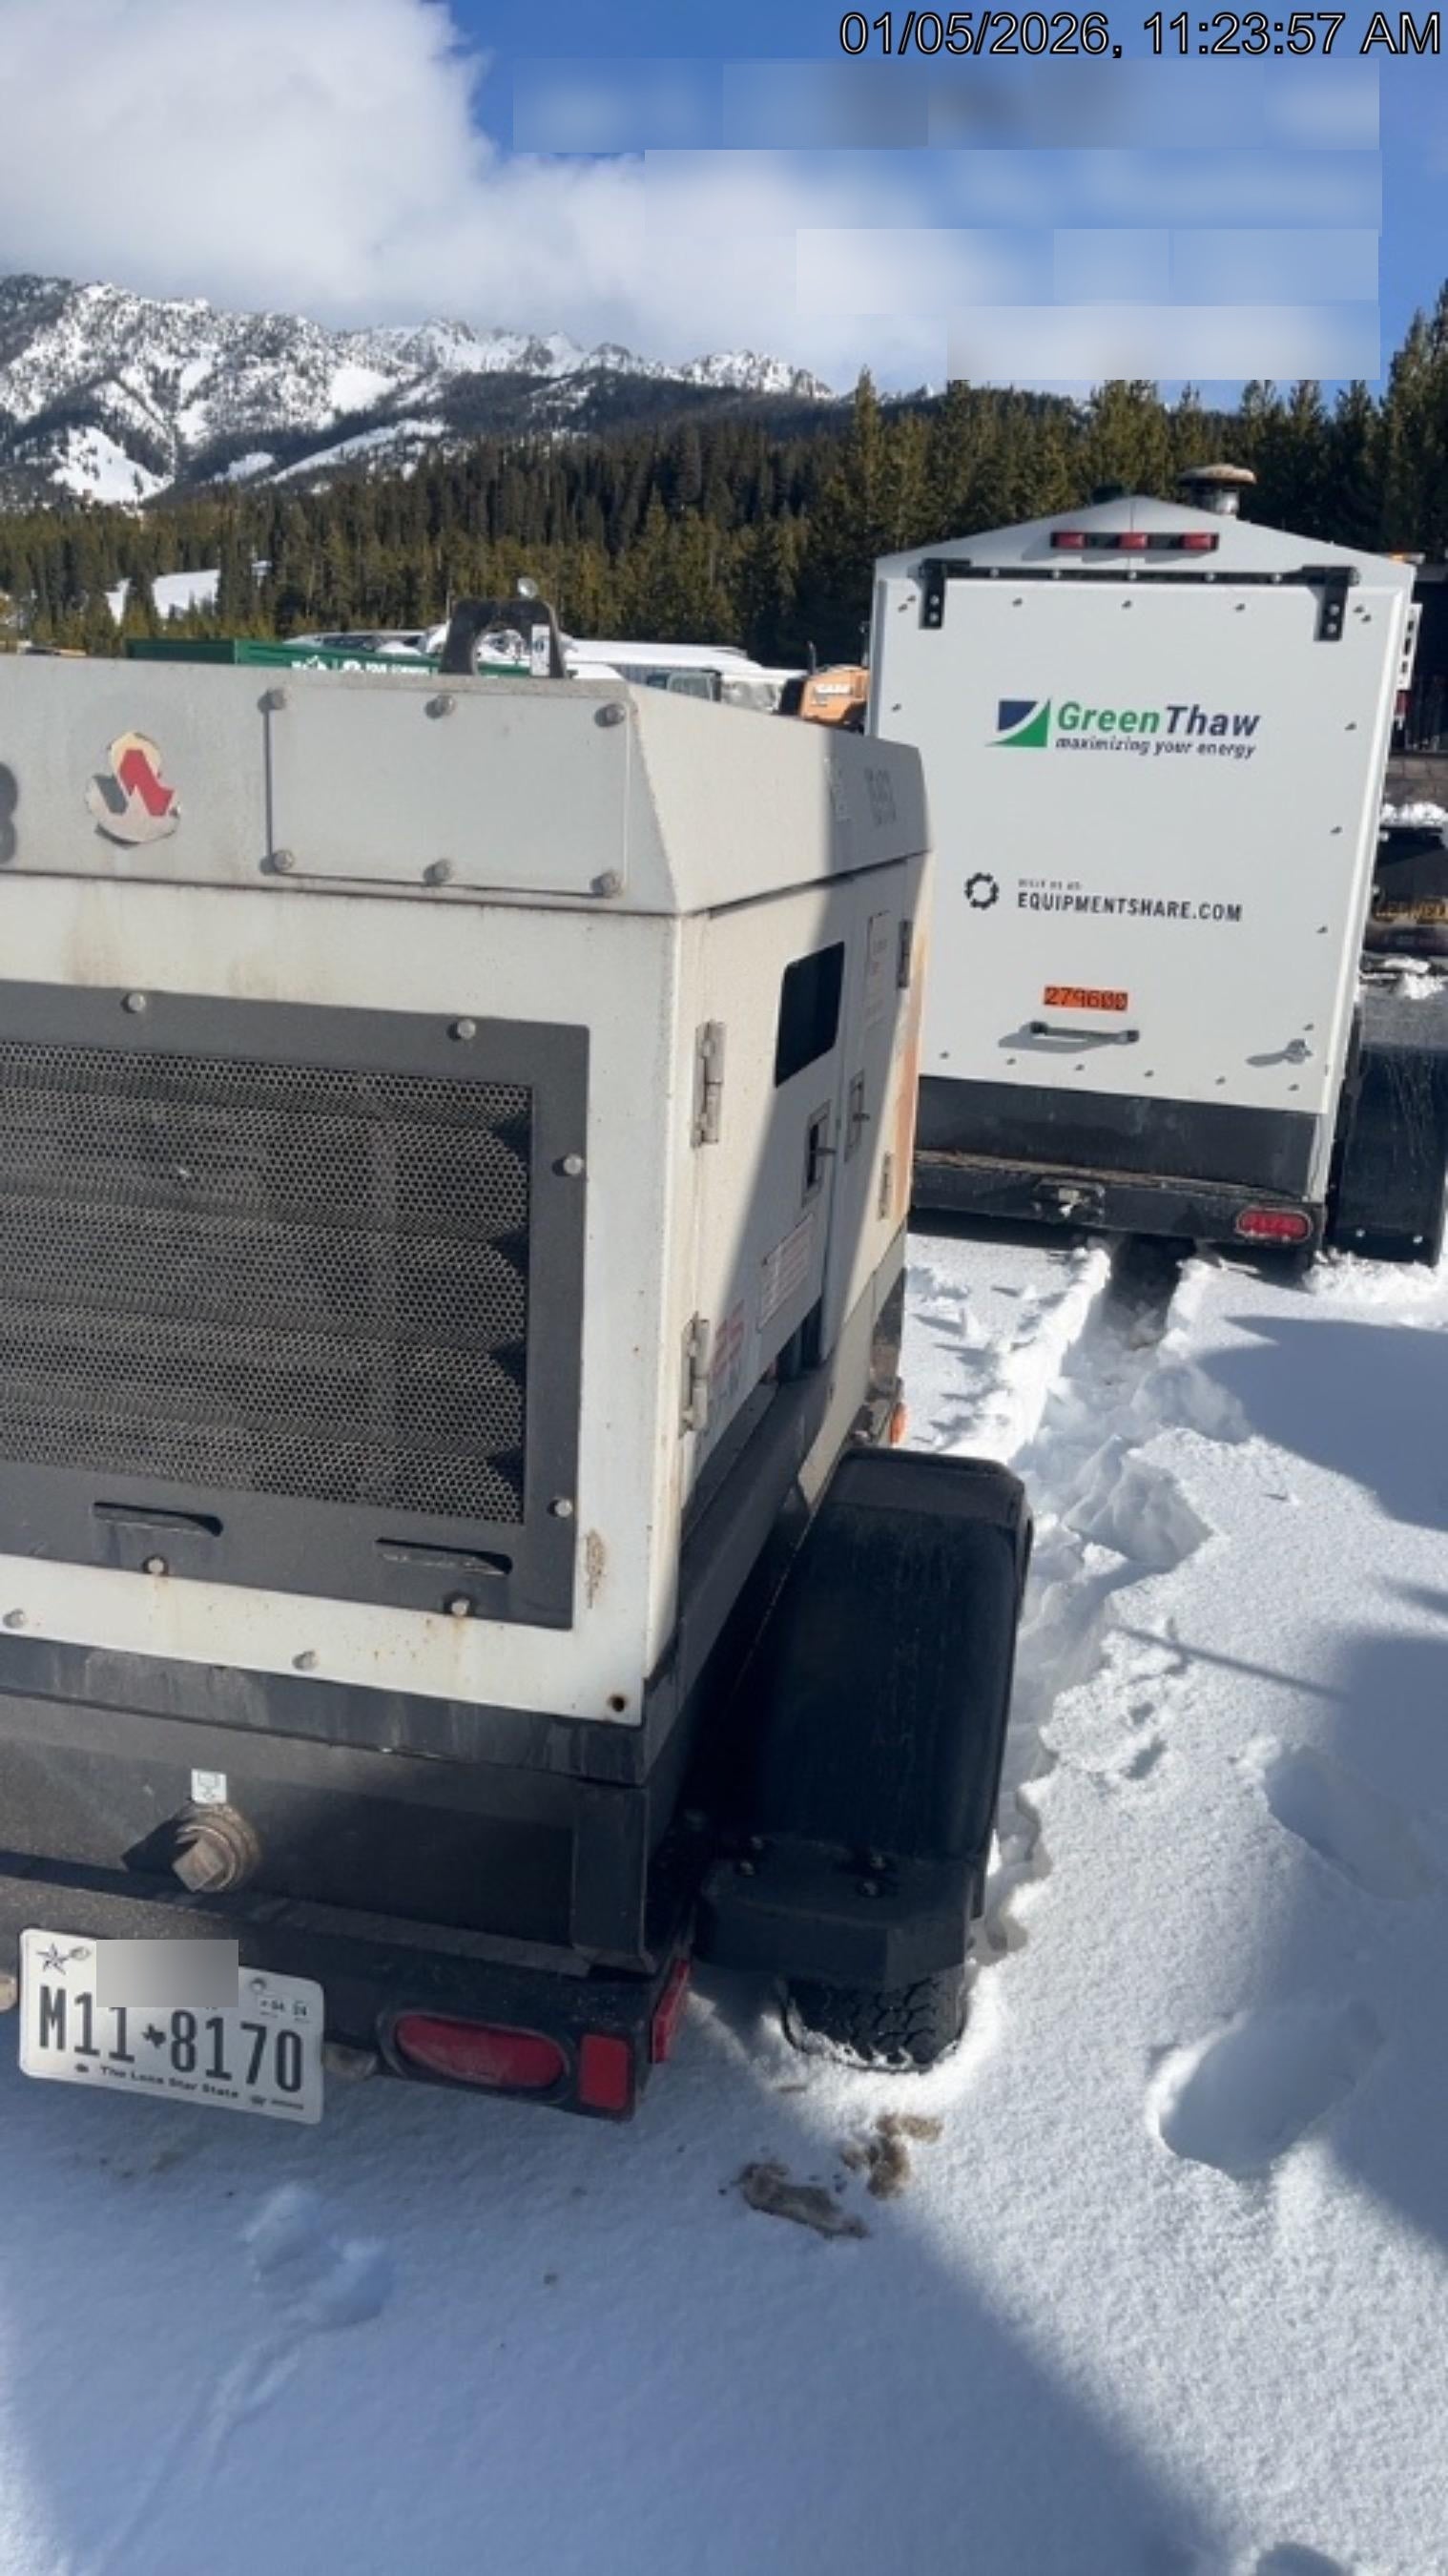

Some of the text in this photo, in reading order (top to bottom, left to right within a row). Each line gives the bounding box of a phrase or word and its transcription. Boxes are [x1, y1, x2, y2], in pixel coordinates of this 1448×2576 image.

[1055, 735, 1256, 759] maximizing your energy
[1017, 892, 1243, 923] EQUIPMENTSHARE.COM
[1045, 987, 1127, 1010] 279600
[202, 2083, 239, 2099] State
